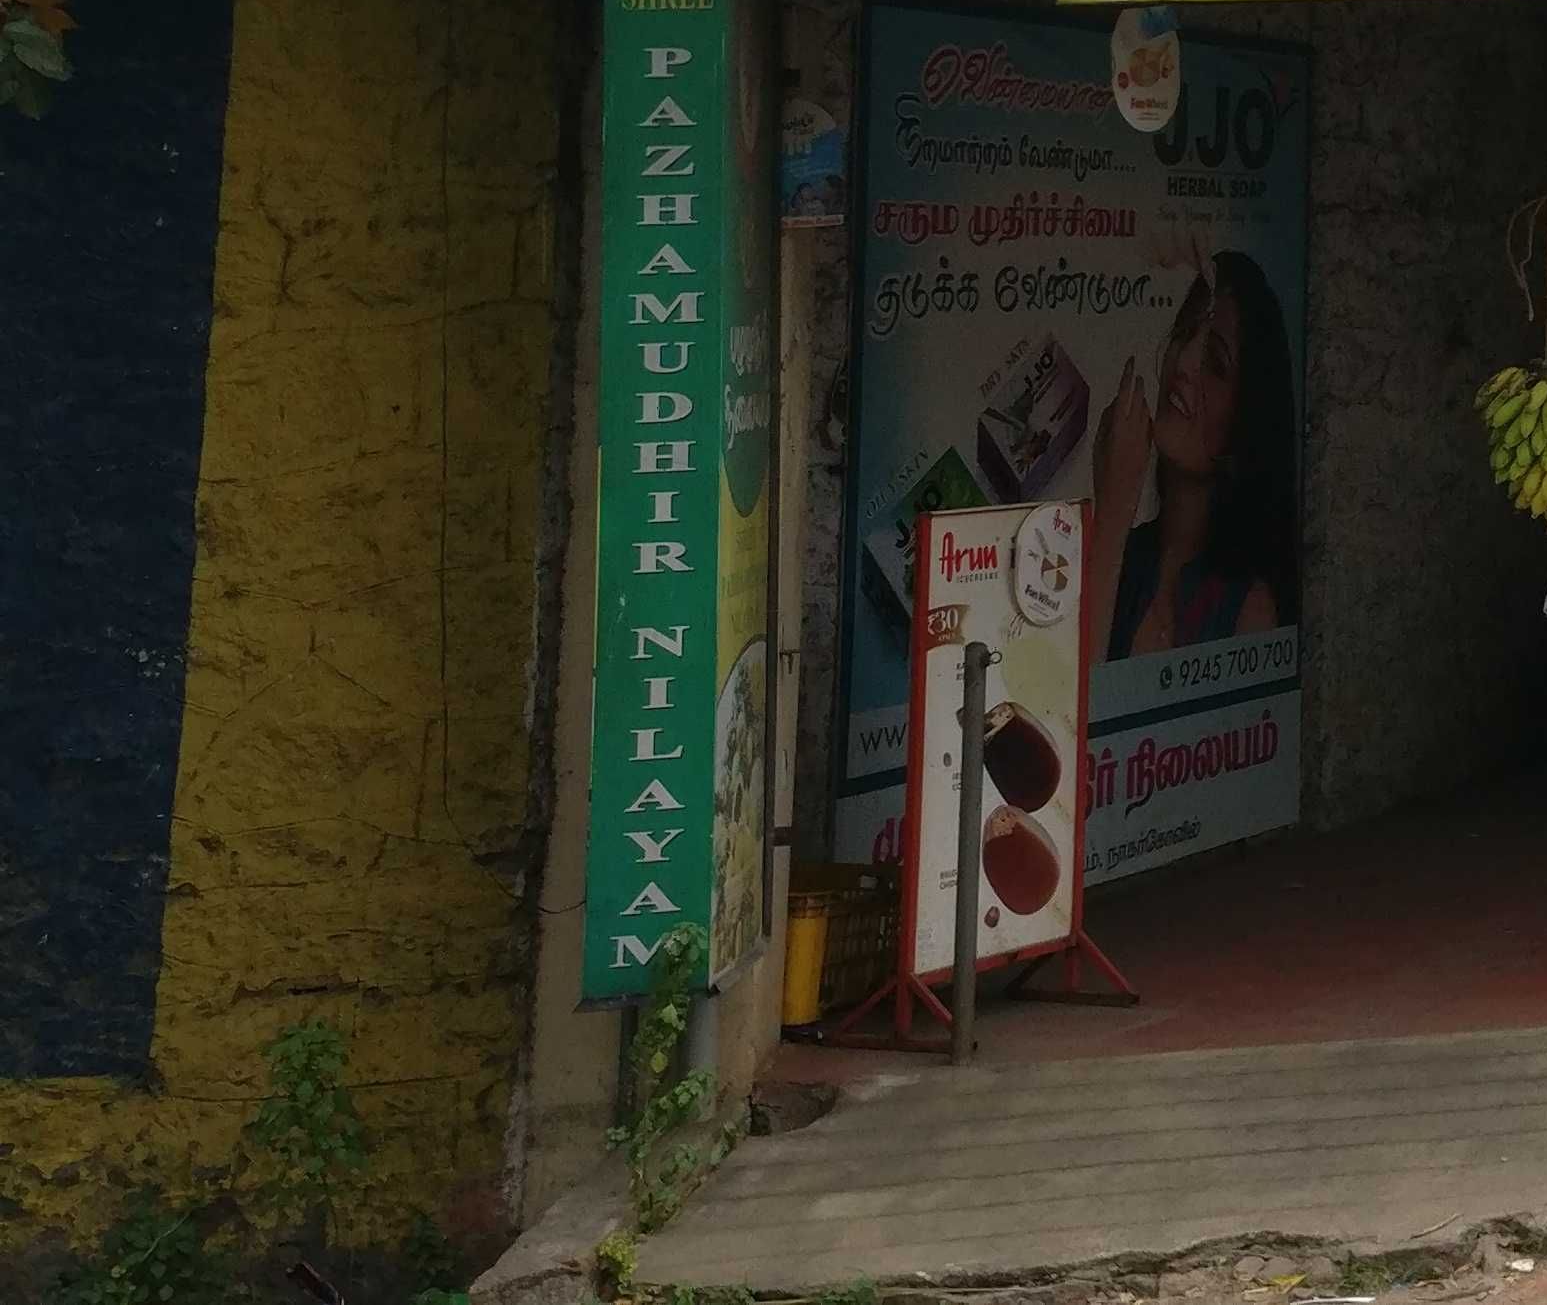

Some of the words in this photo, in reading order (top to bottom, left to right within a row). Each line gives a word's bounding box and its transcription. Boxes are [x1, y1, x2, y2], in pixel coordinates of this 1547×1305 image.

[1167, 176, 1225, 198] HERBAL
[1229, 179, 1267, 199] SOAP
[873, 198, 960, 245] சரும
[628, 47, 704, 574] PAZHAMUDHIR
[871, 256, 979, 337] தடுக்க
[939, 532, 998, 582] Arun
[1179, 652, 1222, 687] 9245
[1226, 646, 1258, 679] 700
[1261, 637, 1294, 671] 700
[609, 625, 689, 968] NILAYAM
[1125, 709, 1279, 820] நிலையம்
